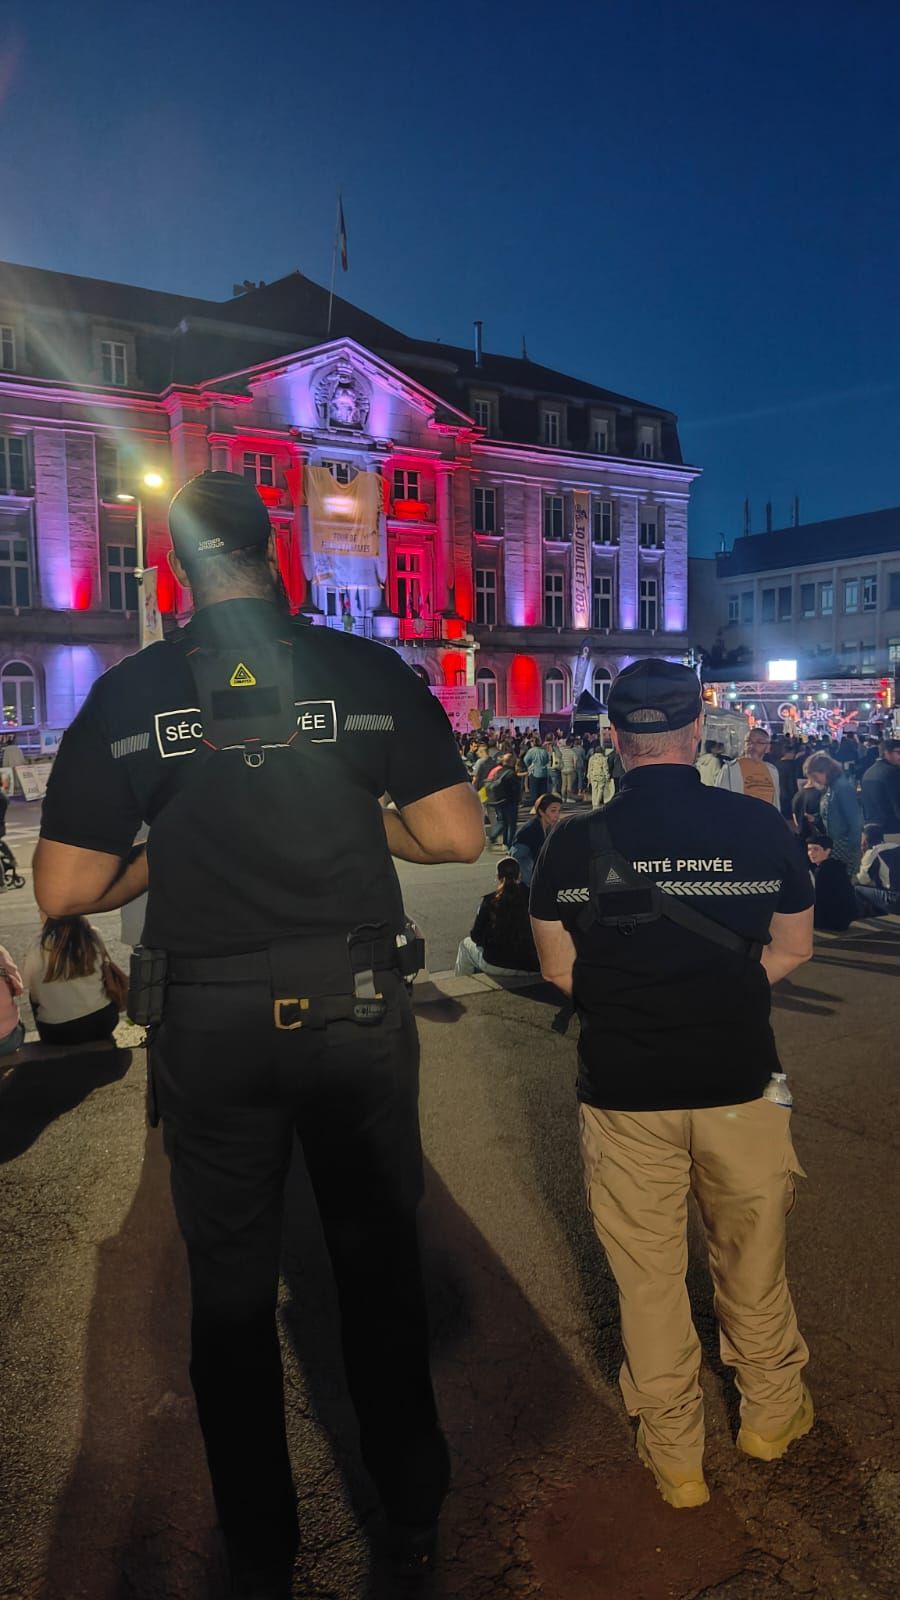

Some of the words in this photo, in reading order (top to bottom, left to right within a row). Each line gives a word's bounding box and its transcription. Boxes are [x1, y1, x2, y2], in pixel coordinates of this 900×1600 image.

[575, 526, 585, 540] 30
[575, 541, 585, 587] JUILLET
[676, 857, 733, 872] PRIVÉE
